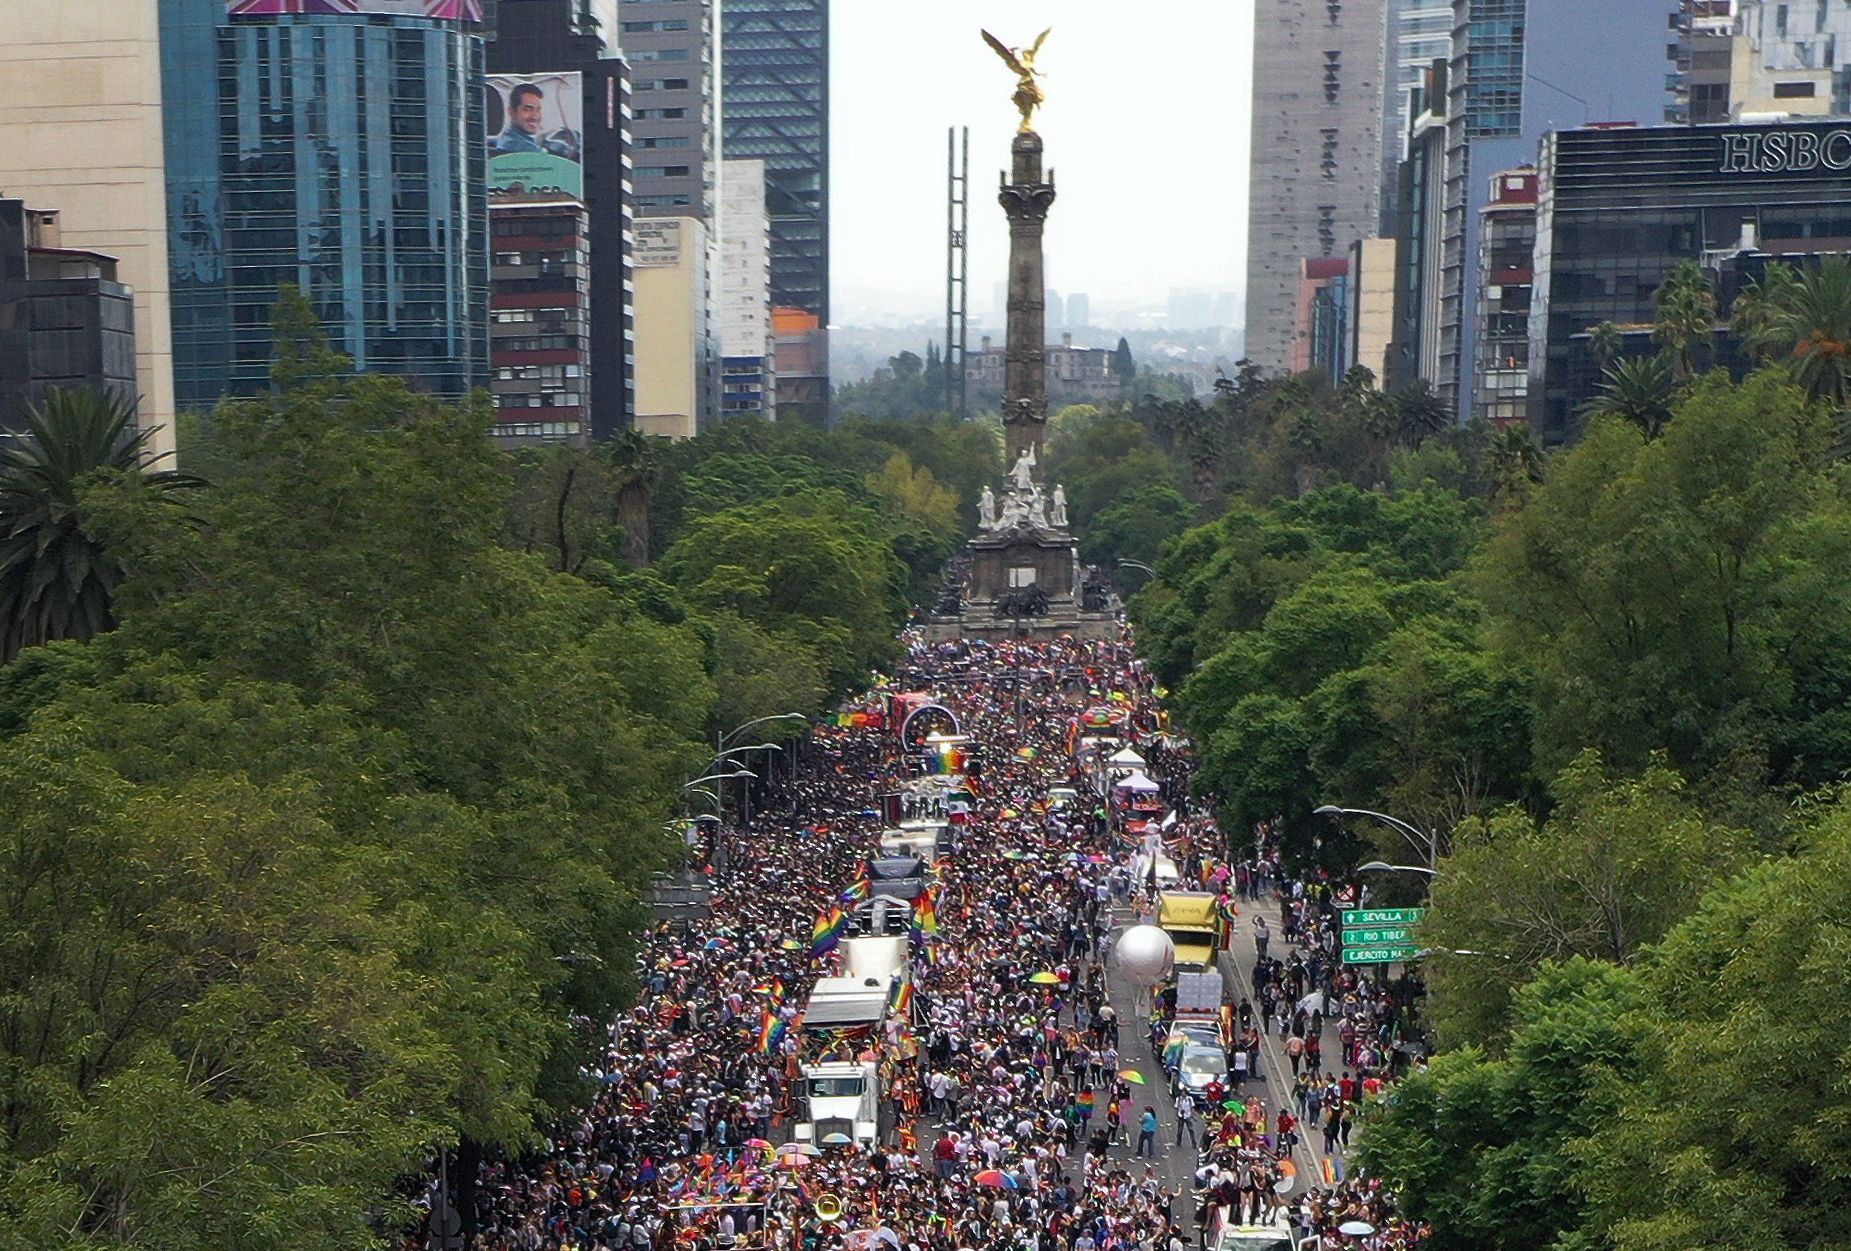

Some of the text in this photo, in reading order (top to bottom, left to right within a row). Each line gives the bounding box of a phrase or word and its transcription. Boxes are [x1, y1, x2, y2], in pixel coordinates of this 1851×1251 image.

[1719, 130, 1851, 172] HSBC
[1362, 913, 1402, 921] SEVILLA
[1363, 932, 1378, 941] RIO
